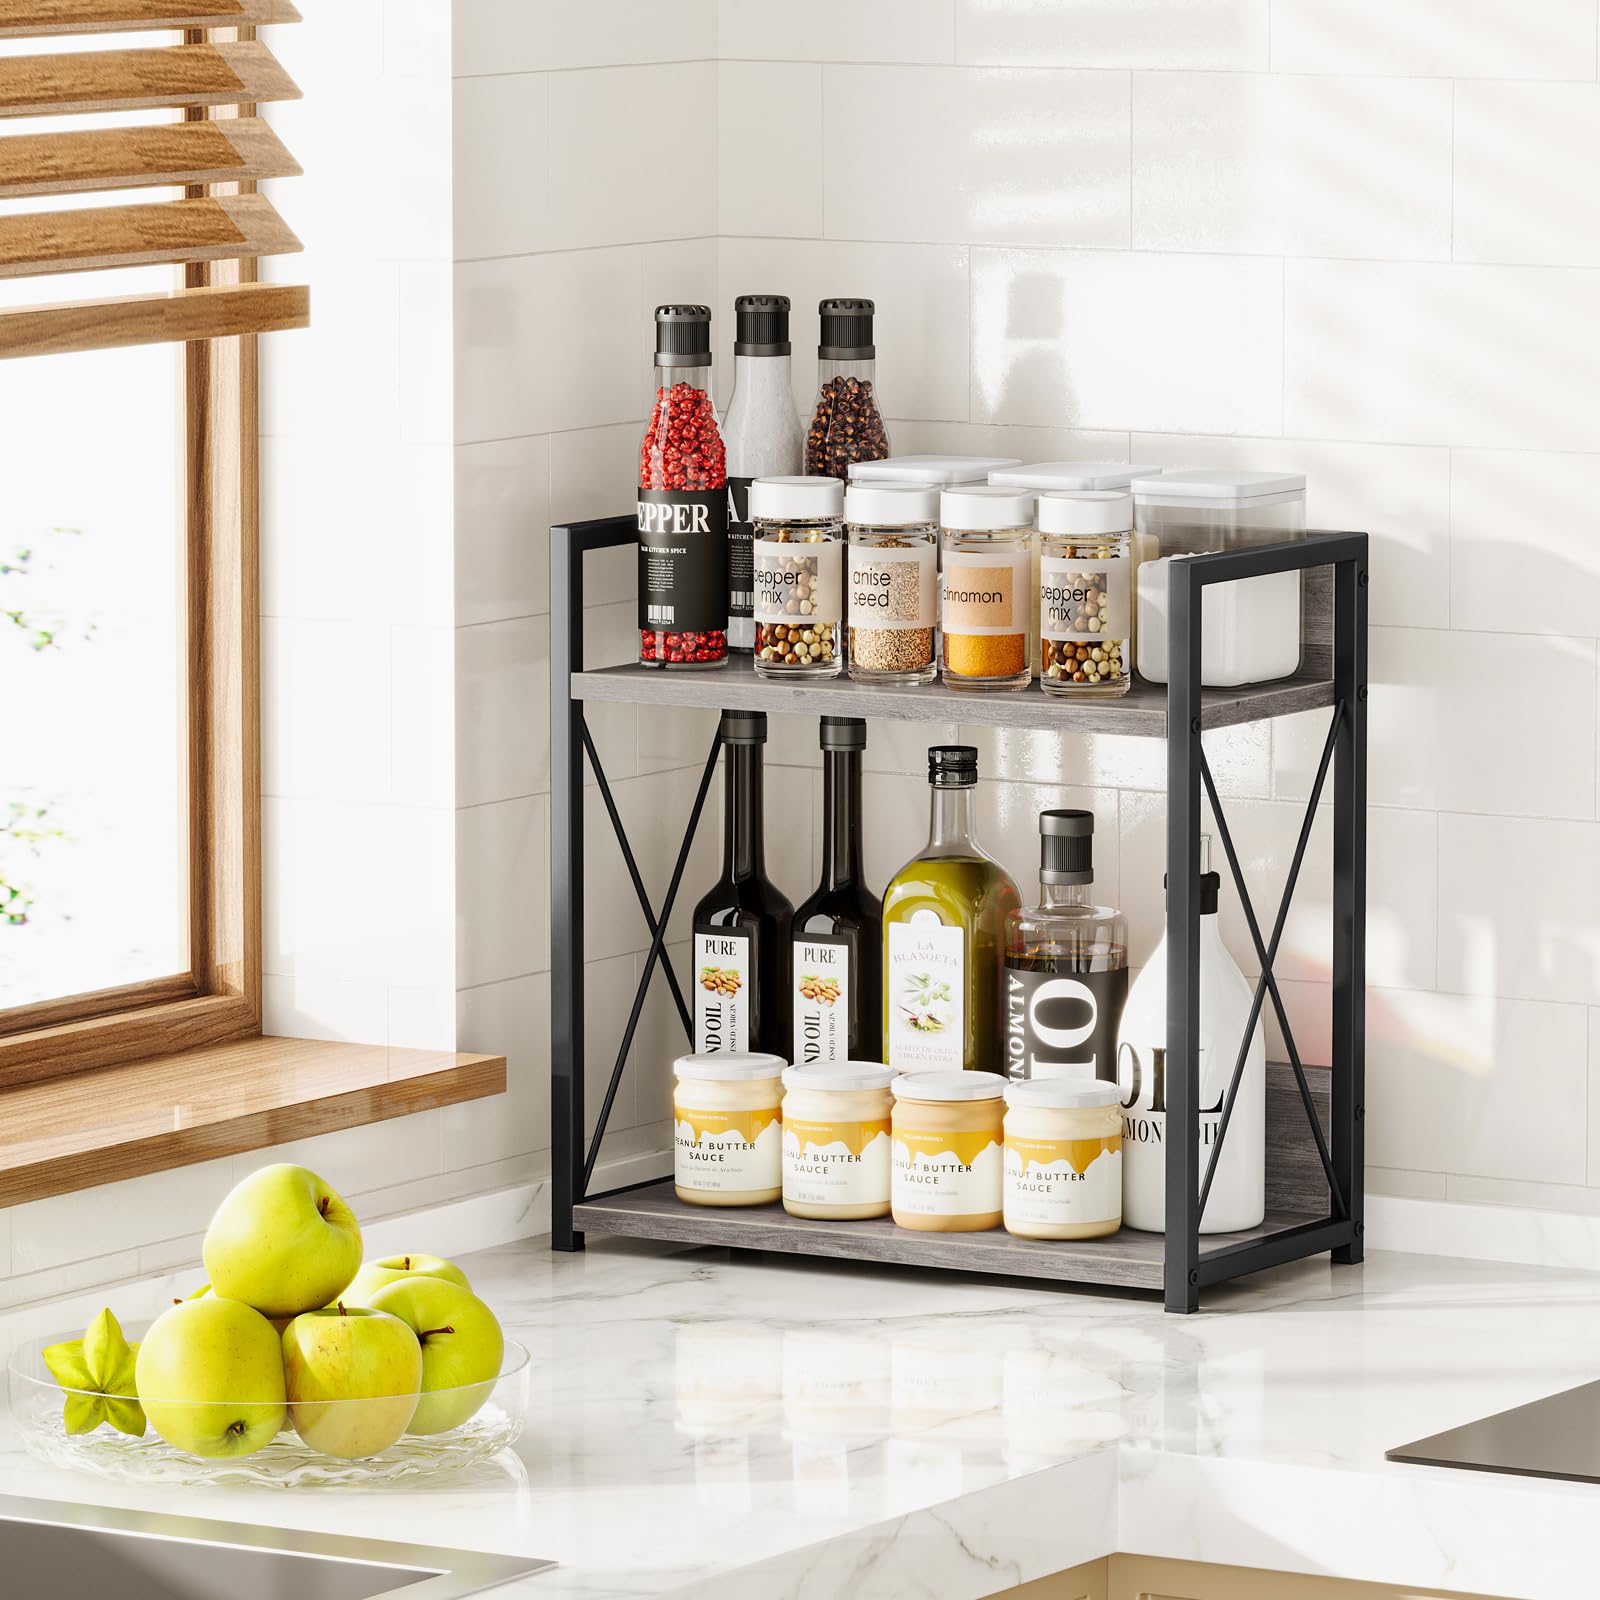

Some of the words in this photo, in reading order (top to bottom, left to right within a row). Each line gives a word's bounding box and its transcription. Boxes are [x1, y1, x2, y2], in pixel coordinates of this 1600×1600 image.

[853, 567, 891, 587] anise
[761, 588, 783, 604] mix
[853, 590, 889, 608] seed
[1049, 604, 1071, 621] mix
[705, 939, 737, 956] PURE
[916, 941, 935, 951] LA
[804, 947, 836, 964] PURE
[705, 1002, 722, 1031] OIL
[804, 1011, 821, 1039] OIL
[708, 1141, 756, 1152] BUTTER
[689, 1151, 725, 1162] SAUCE
[813, 1154, 862, 1163] BUTTER
[794, 1163, 829, 1175] SAUCE
[923, 1164, 972, 1173] BUTTER
[903, 1173, 939, 1185] SAUCE
[1036, 1172, 1086, 1182] BUTTER
[1016, 1182, 1053, 1193] SAUCE
